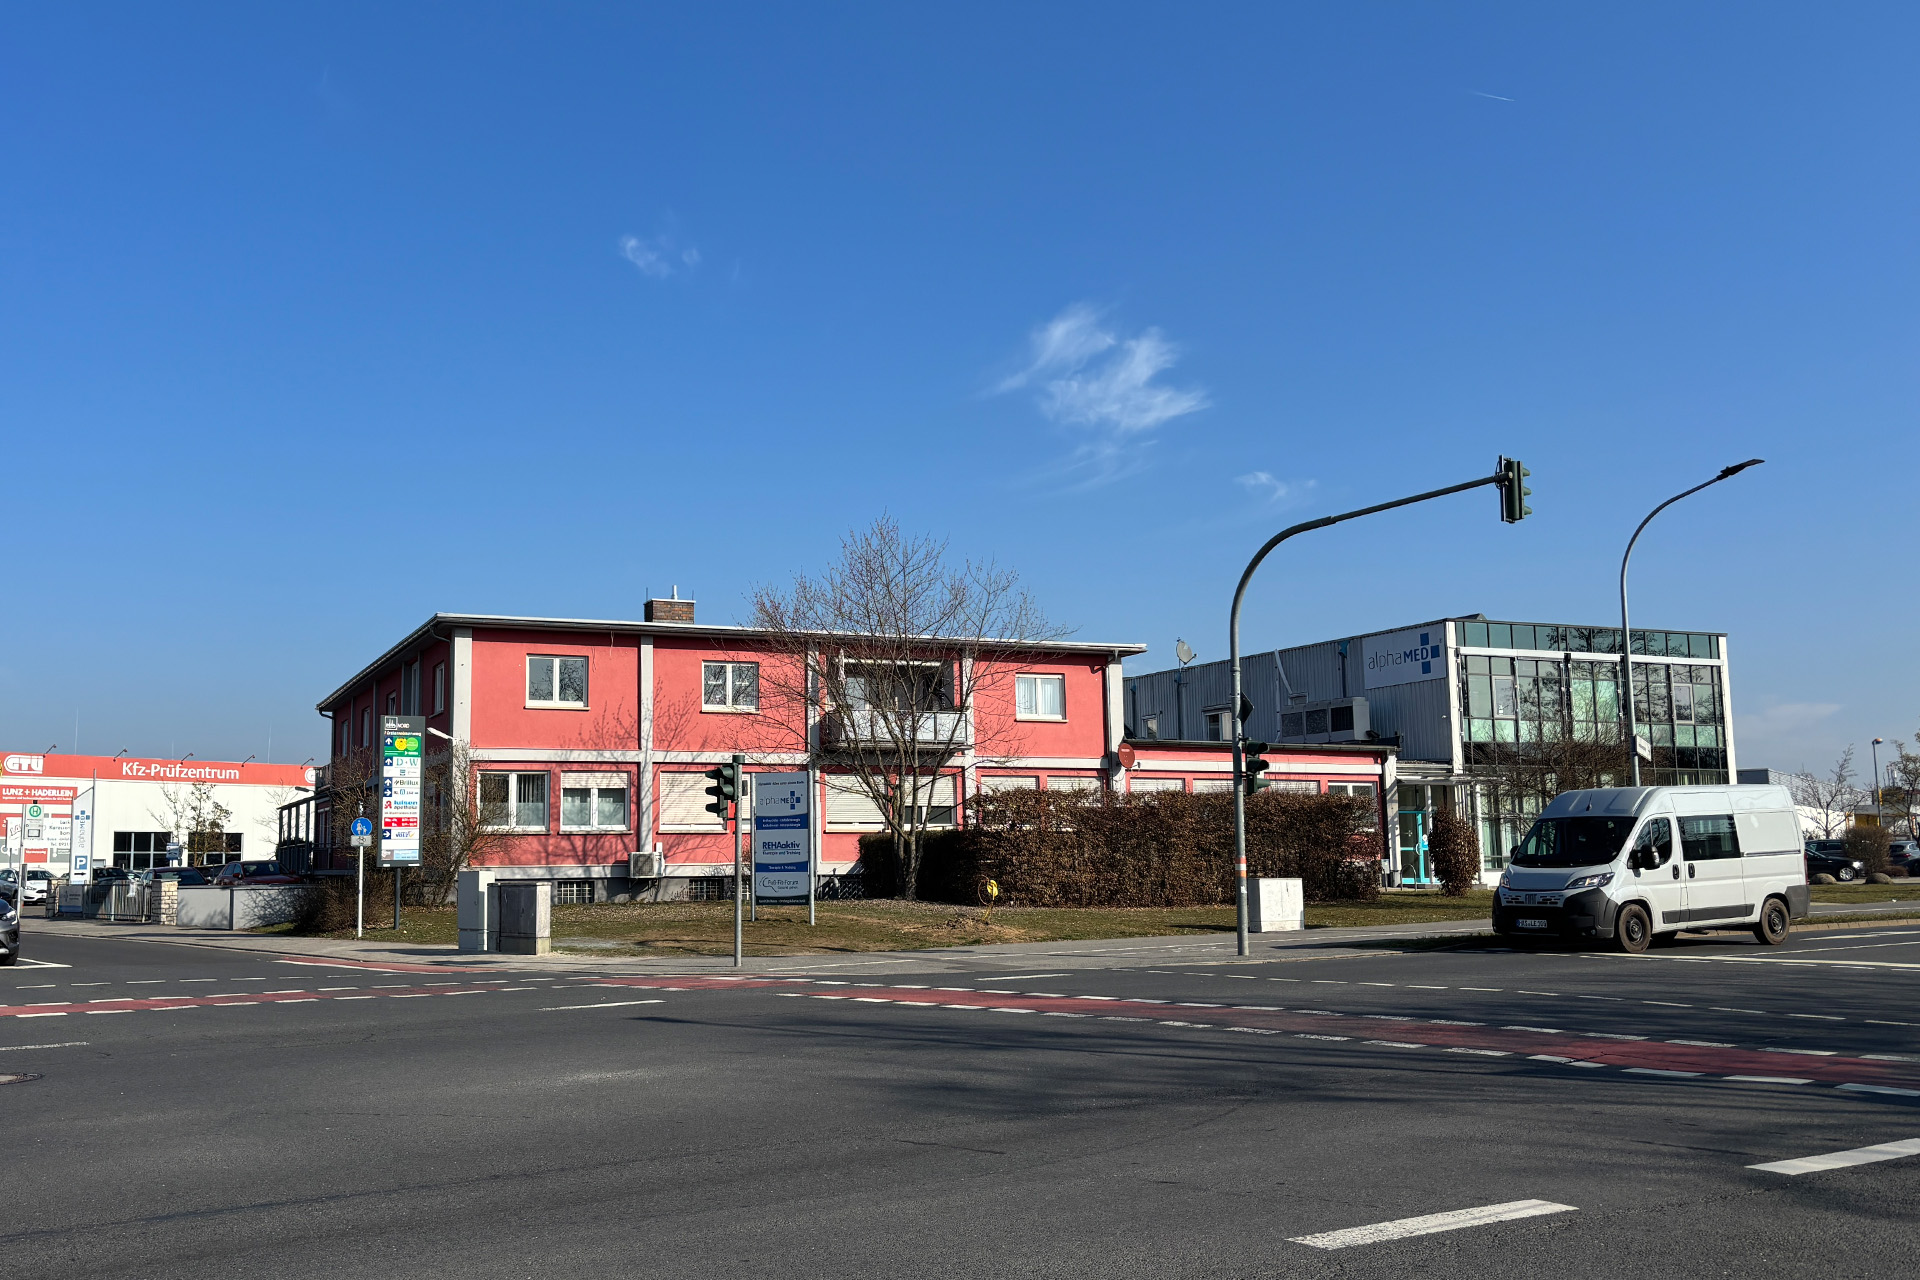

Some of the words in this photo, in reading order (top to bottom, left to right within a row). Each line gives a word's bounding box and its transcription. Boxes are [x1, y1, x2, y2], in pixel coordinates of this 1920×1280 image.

[1368, 646, 1429, 672] alphaMED
[122, 761, 239, 780] Kfz-Prüfzentrum
[760, 796, 795, 806] alphaMED
[762, 841, 801, 849] REHAaktiv
[76, 857, 86, 869] P
